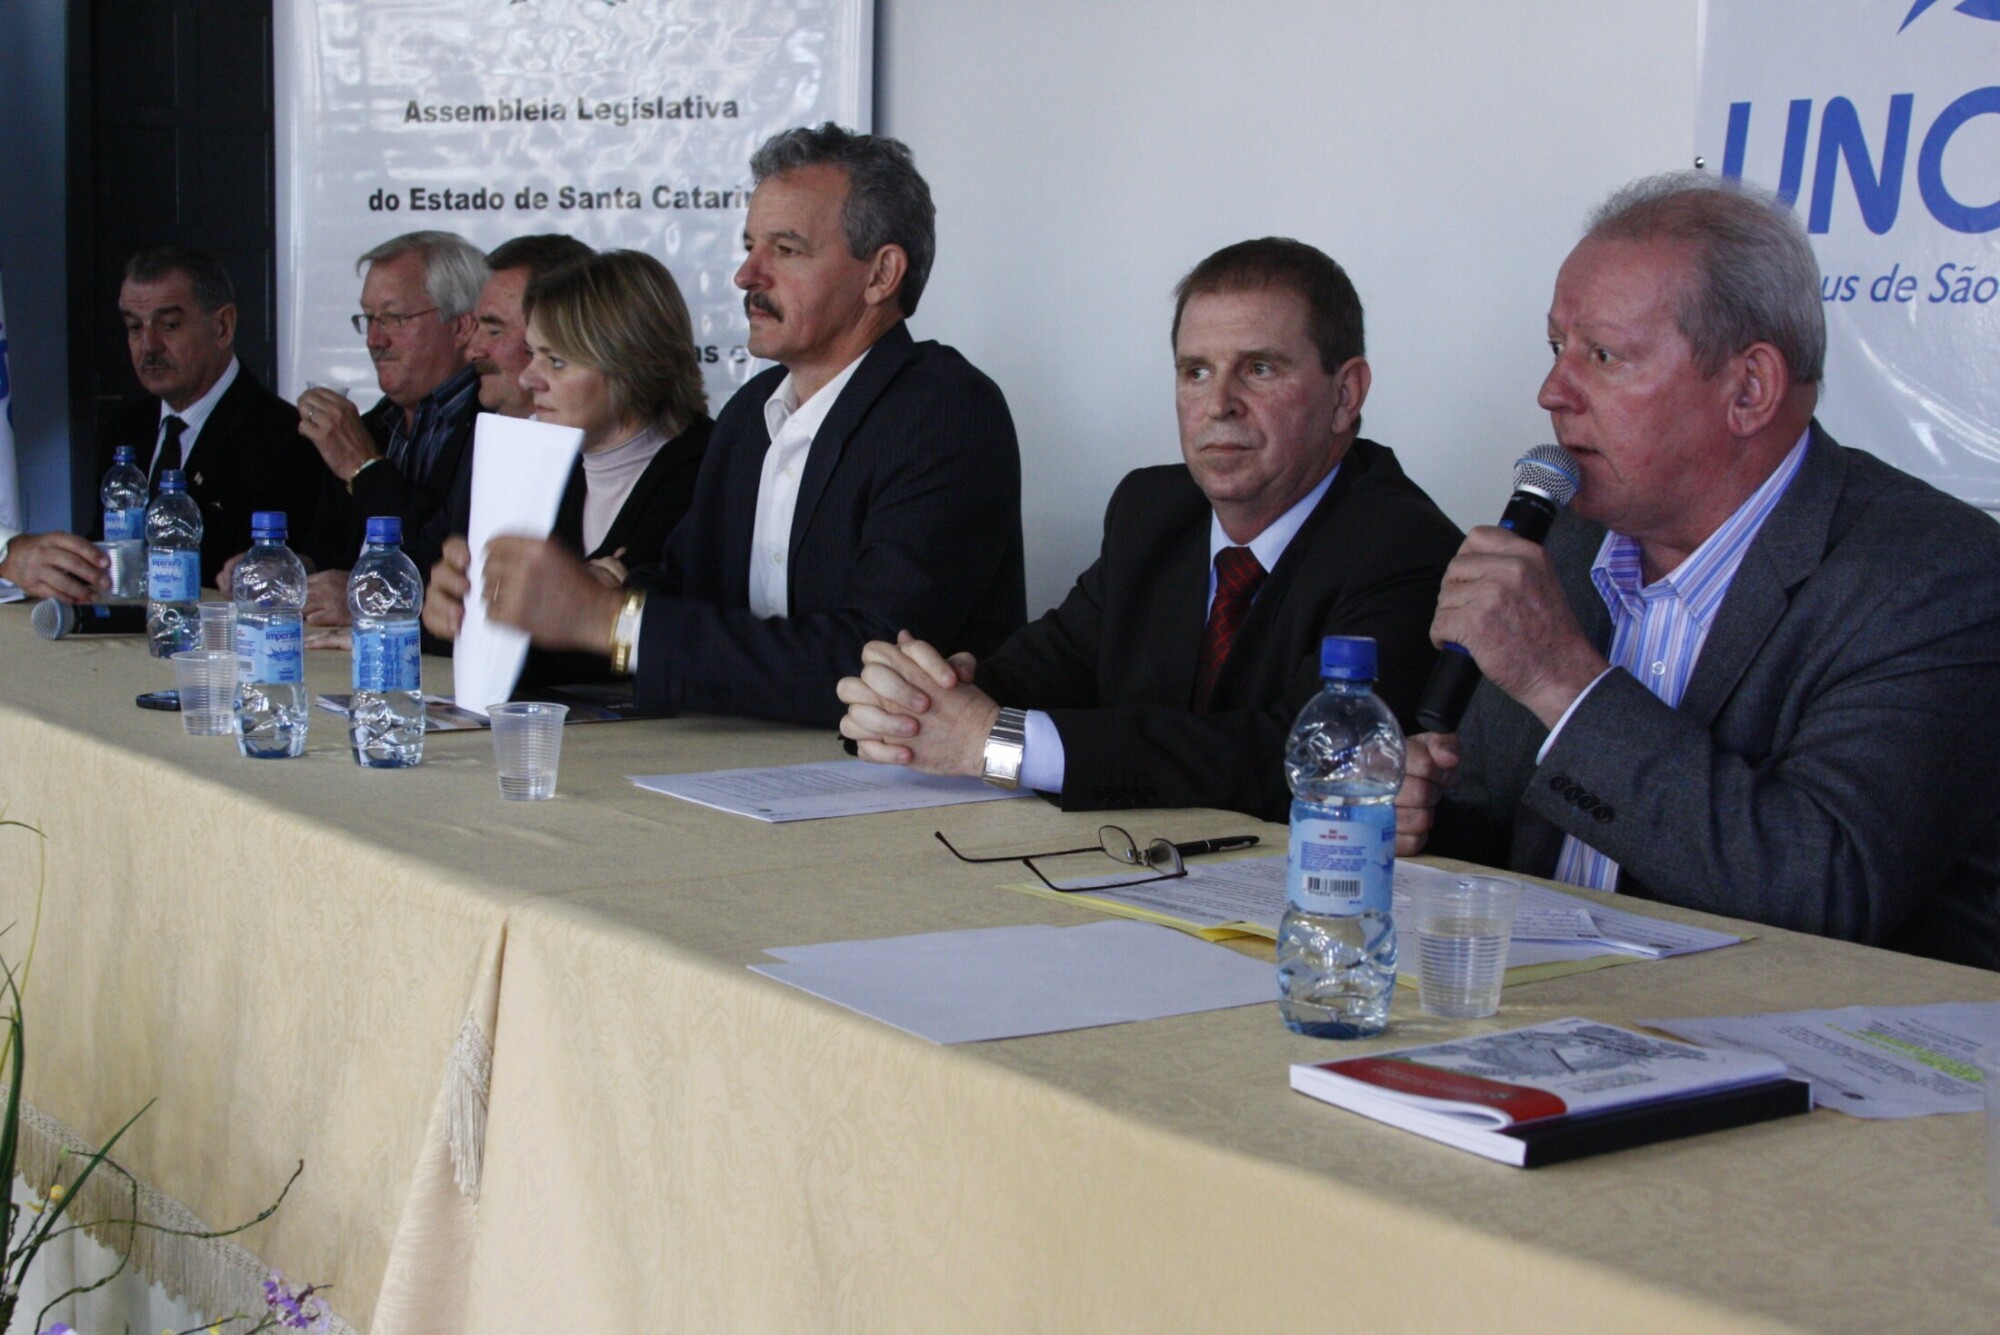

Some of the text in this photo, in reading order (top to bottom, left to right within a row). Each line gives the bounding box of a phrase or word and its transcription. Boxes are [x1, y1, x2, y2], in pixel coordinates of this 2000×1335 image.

[403, 95, 739, 127] Assembleia Legislativa
[368, 188, 400, 211] do
[409, 187, 505, 211] Estado
[514, 186, 549, 210] de
[558, 186, 641, 210] Santa
[1869, 263, 1918, 303] de
[1928, 262, 1999, 304] São
